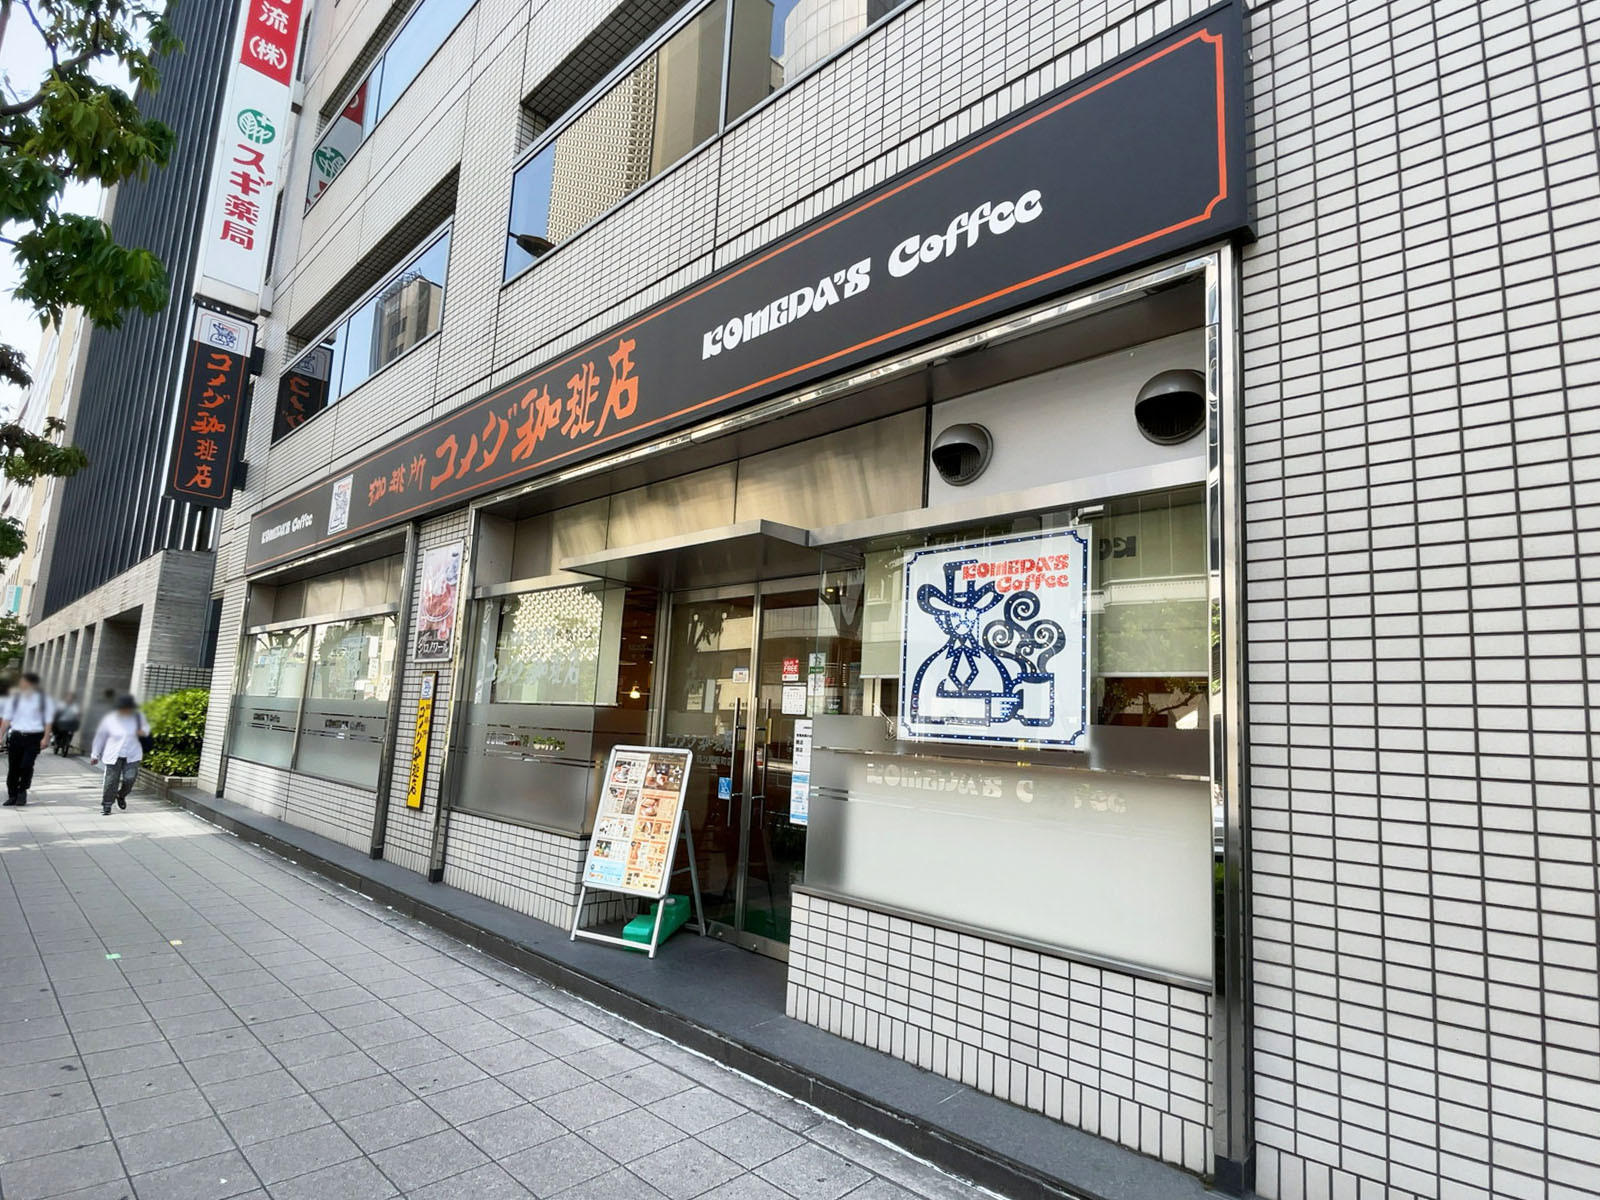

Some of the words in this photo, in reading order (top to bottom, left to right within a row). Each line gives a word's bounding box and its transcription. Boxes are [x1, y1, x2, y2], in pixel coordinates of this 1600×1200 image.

[219, 143, 273, 251] スギ薬局
[701, 257, 872, 361] KOMEDA'S
[887, 189, 1043, 278] Coffee
[185, 352, 233, 488] コメダ珈琲店
[429, 338, 640, 491] コメダ珈琲店
[962, 553, 1070, 581] KOMEDA'S
[996, 573, 1070, 594] Coffee
